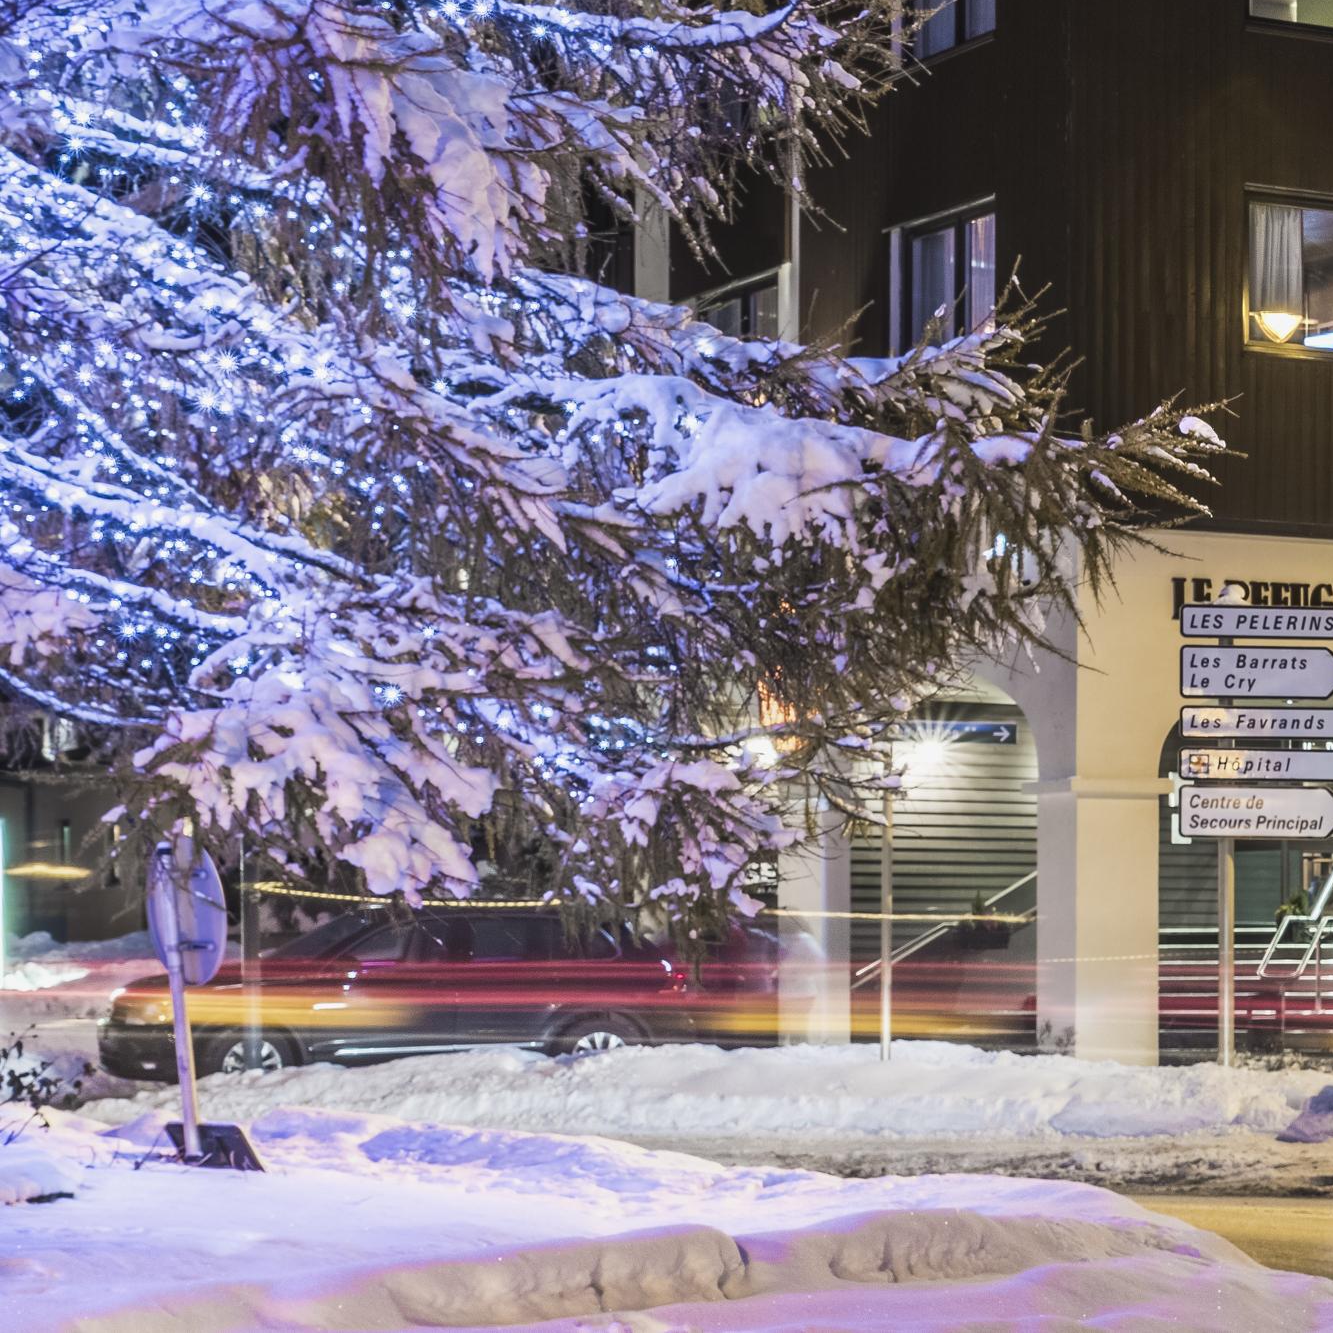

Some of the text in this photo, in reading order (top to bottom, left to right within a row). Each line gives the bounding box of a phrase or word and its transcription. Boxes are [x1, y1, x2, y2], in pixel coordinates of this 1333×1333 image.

[1171, 577, 1212, 620] LE
[1189, 614, 1224, 629] LES
[1189, 654, 1308, 670] Les Barrats
[1189, 673, 1256, 692] Le Cry
[1189, 714, 1326, 730] Les Favrands
[1216, 757, 1291, 775] Hôpital
[1189, 794, 1264, 810] Centre de
[1189, 815, 1324, 833] Secours Principal
